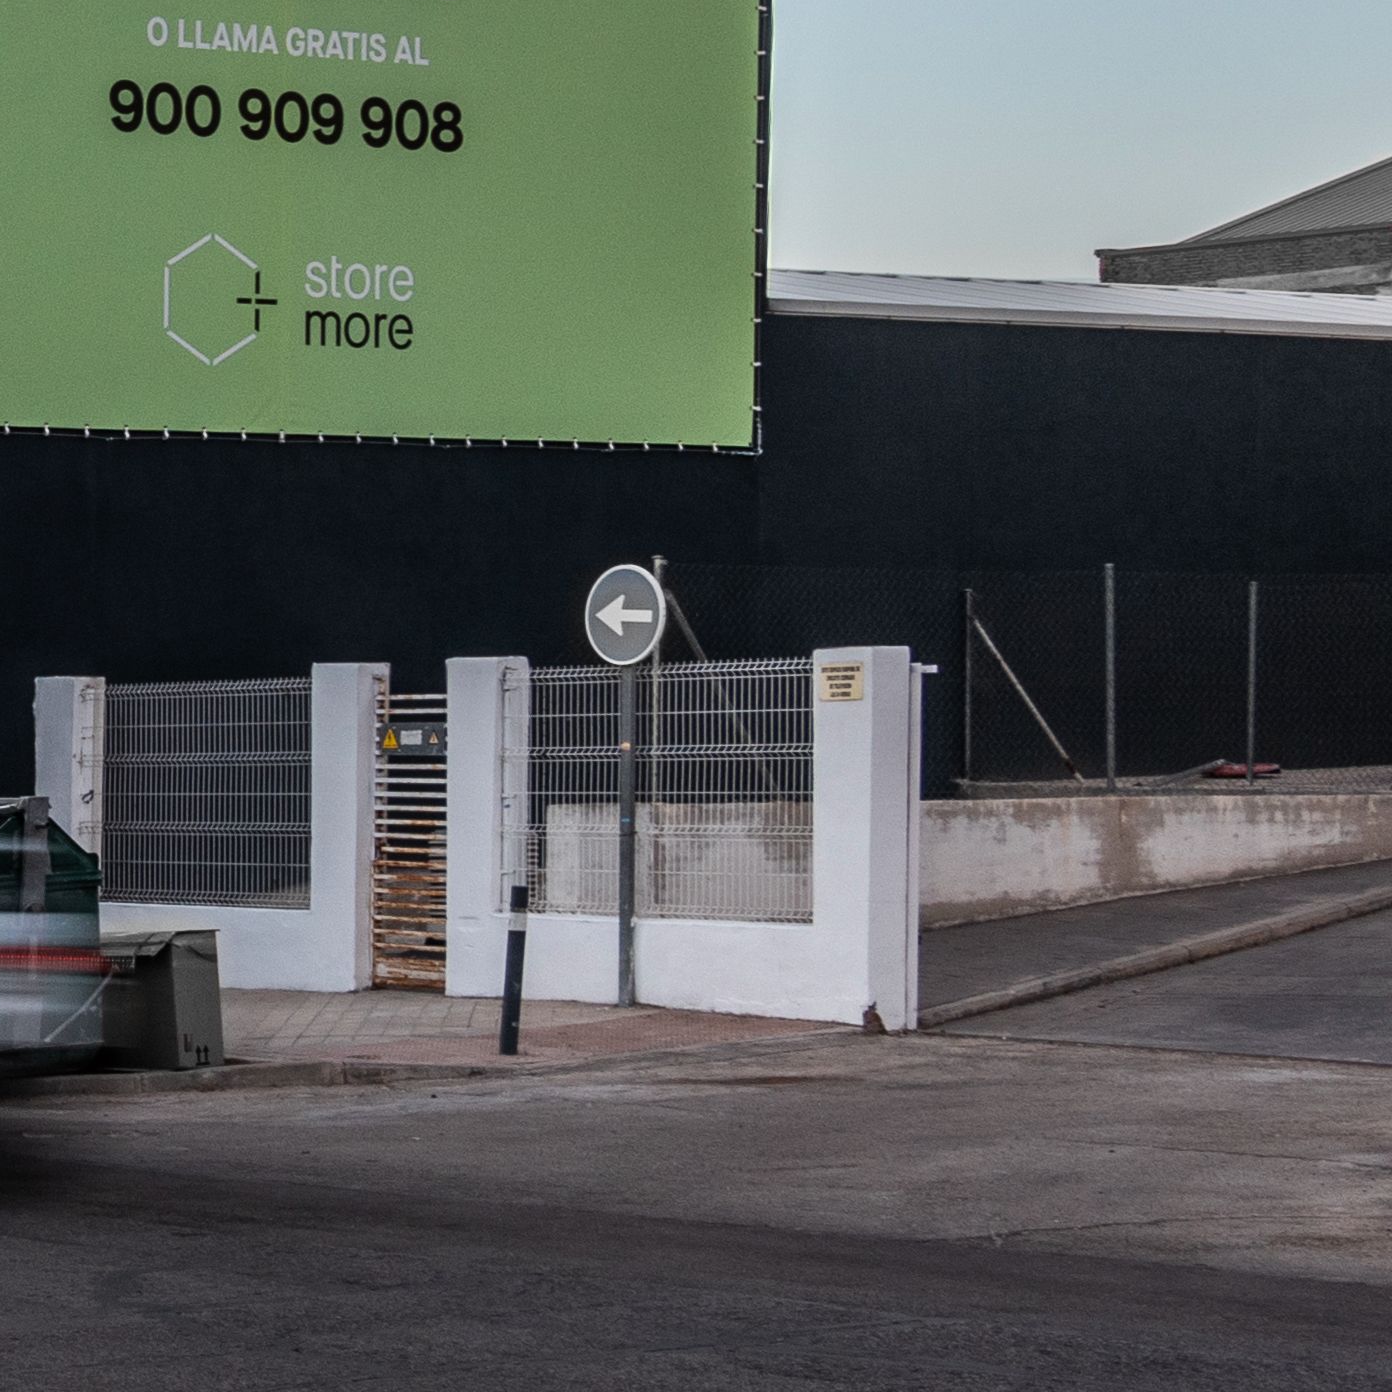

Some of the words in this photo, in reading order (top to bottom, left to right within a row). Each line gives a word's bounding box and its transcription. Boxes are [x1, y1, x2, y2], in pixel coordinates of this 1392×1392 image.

[147, 16, 169, 47] O
[177, 18, 279, 54] LLAMA
[285, 27, 387, 63] GRATIS
[394, 35, 430, 66] AL
[109, 79, 221, 138] 900
[238, 88, 344, 145] 909
[360, 96, 464, 153] 908
[304, 255, 414, 302] store
[304, 310, 414, 350] more
